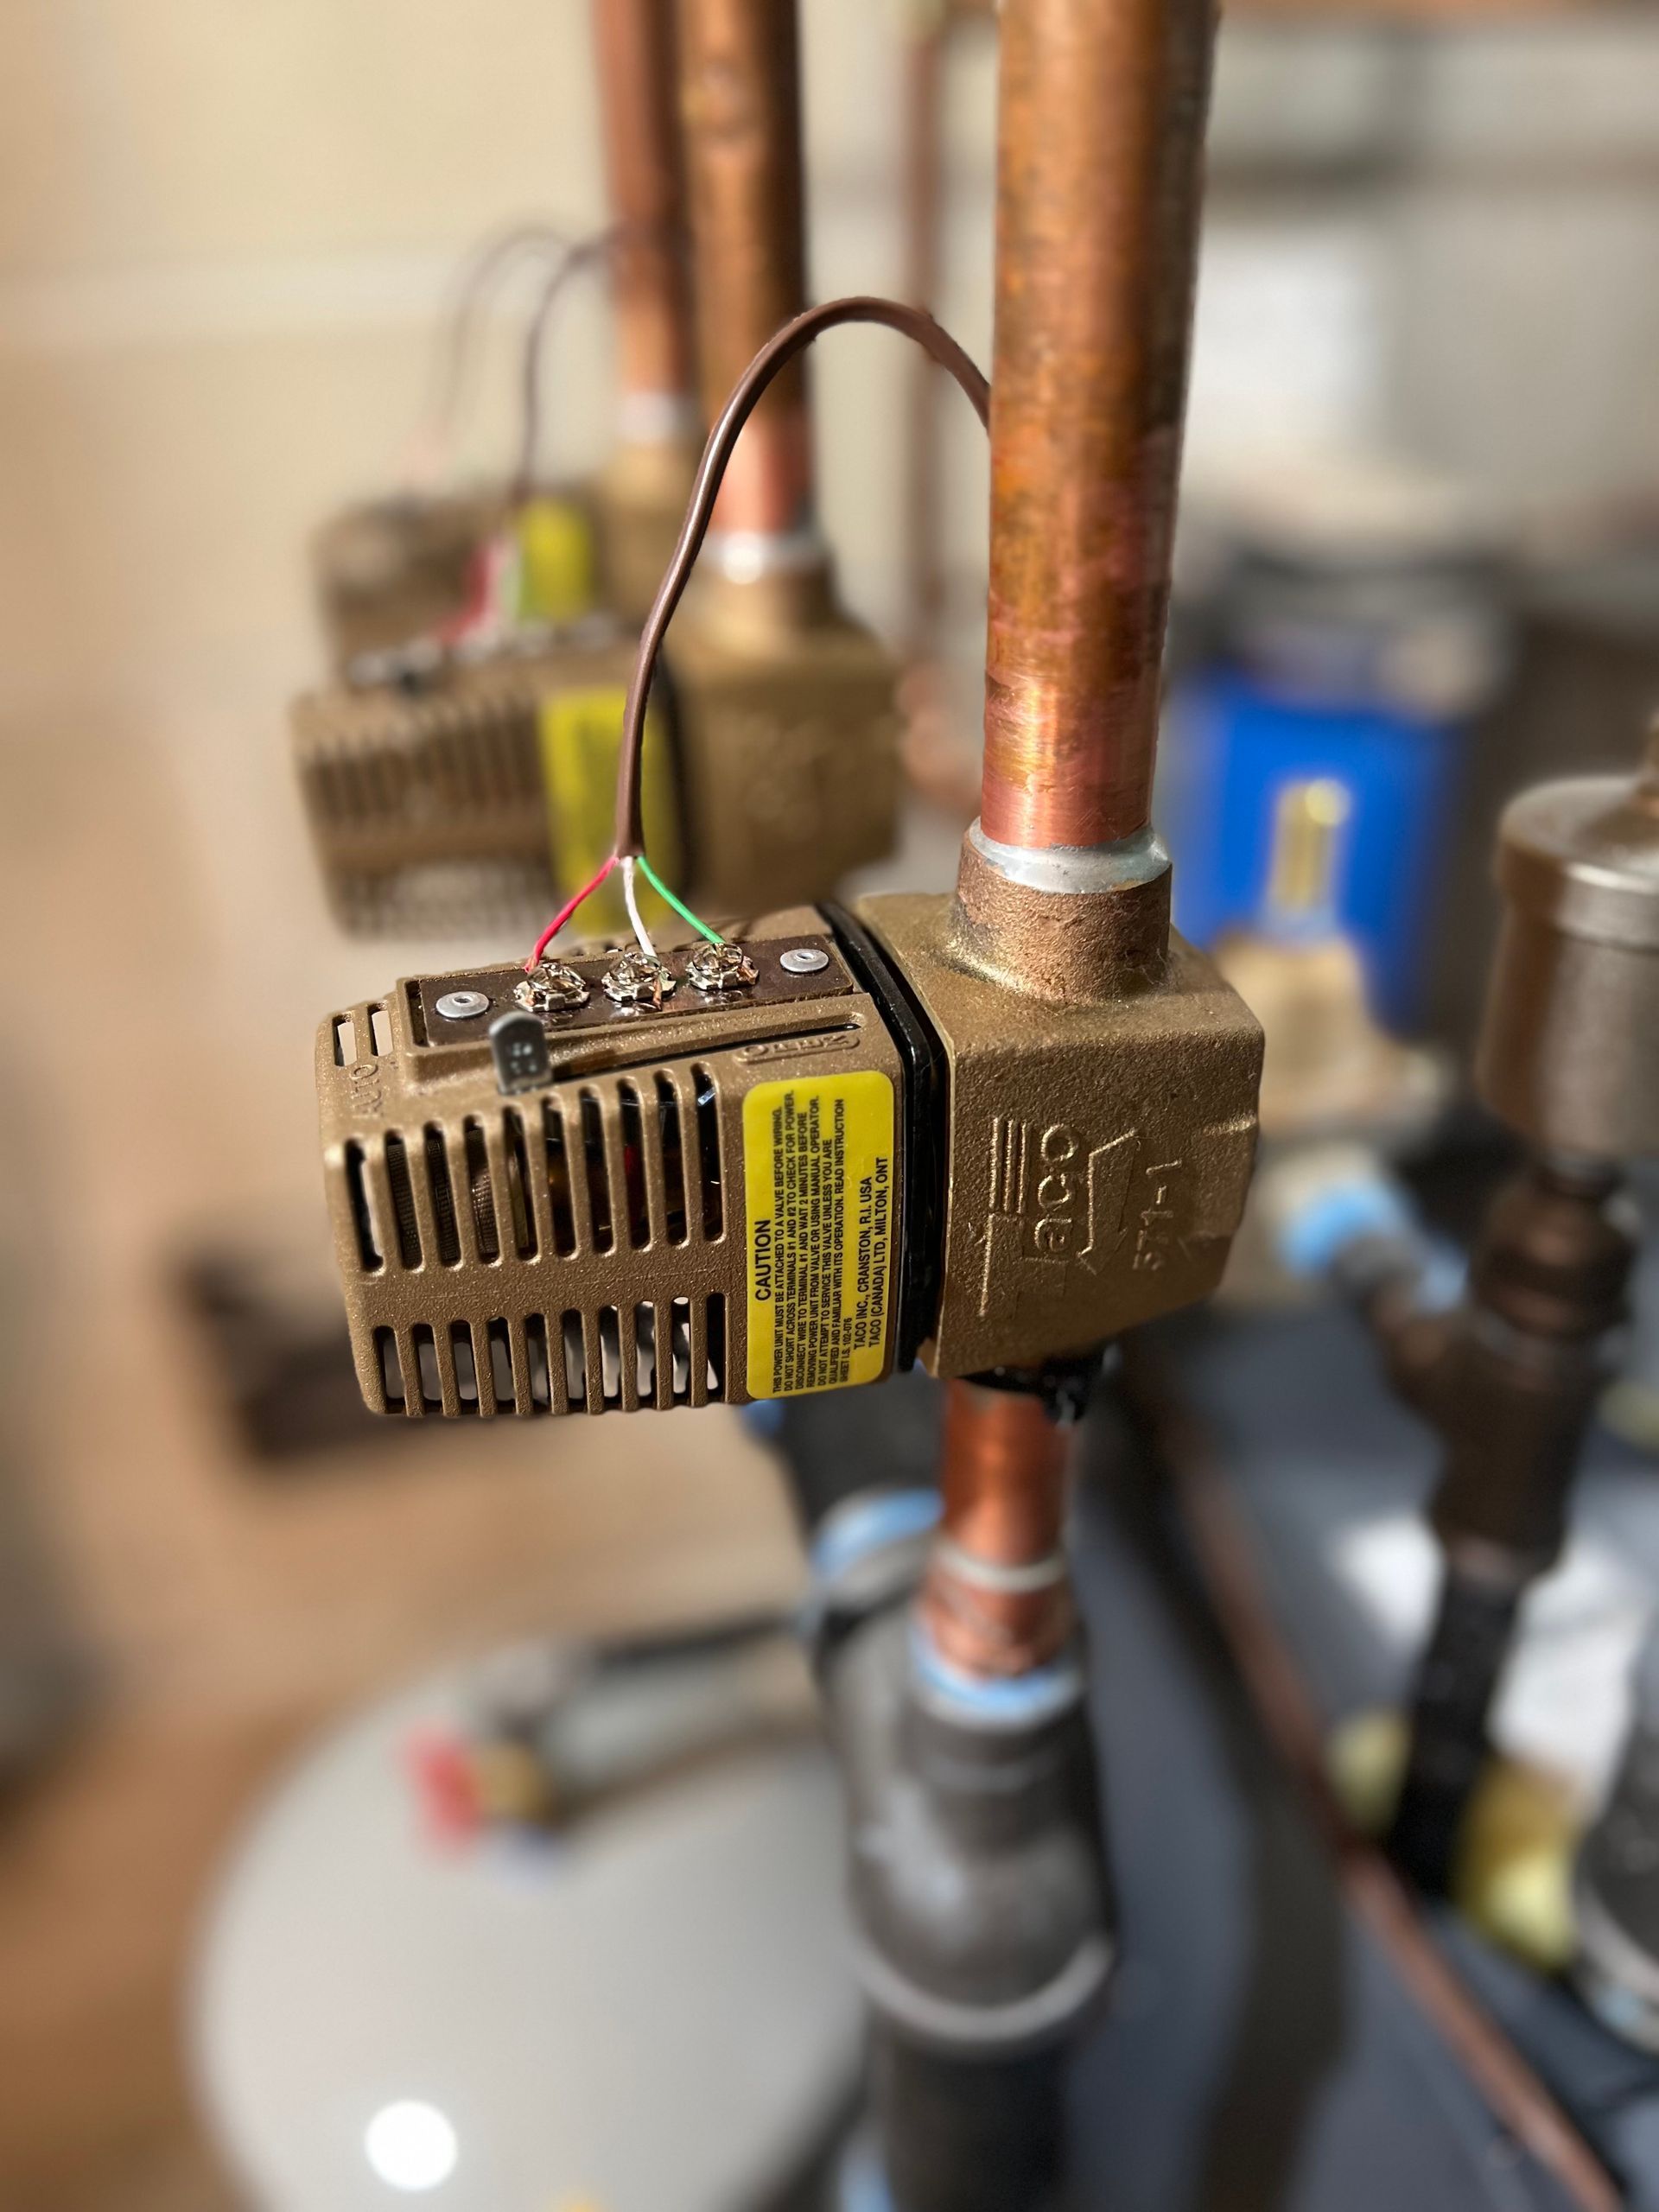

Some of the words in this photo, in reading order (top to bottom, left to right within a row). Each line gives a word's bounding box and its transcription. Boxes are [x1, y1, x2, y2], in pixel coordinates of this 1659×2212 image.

[798, 1113, 807, 1152] BEFORE
[835, 1099, 843, 1166] INSTRUCTION
[823, 1139, 831, 1159] ARE
[774, 1149, 784, 1186] BEFORE
[786, 1156, 796, 1189] CHECK
[798, 1154, 808, 1197] MINUTES
[811, 1156, 820, 1196] MANUAL
[823, 1161, 831, 1181] YOU
[835, 1168, 843, 1193] READ
[875, 1158, 887, 1183] ONT
[787, 1192, 796, 1205] TO
[823, 1184, 832, 1220] UNLESS
[860, 1177, 871, 1203] USA
[775, 1190, 784, 1218] VALVE
[811, 1198, 820, 1226] USING
[860, 1205, 871, 1224] R.I.
[874, 1186, 888, 1236] MILTON,
[799, 1208, 808, 1230] WAIT
[835, 1196, 843, 1250] OPERATION.
[775, 1230, 784, 1241] TO
[810, 1230, 819, 1242] OR
[823, 1223, 831, 1249] VALVE
[754, 1220, 771, 1300] CAUTION
[810, 1245, 819, 1272] VALVE
[822, 1253, 831, 1272] THIS
[834, 1253, 842, 1265] ITS
[858, 1227, 873, 1292] CRANSTON,
[874, 1237, 887, 1263] LTD,
[775, 1244, 784, 1289] ATTACHED
[787, 1253, 796, 1300] TERMINALS
[833, 1268, 842, 1289] WITH
[775, 1292, 784, 1302] BE
[798, 1264, 807, 1306] TERMINAL
[810, 1273, 819, 1297] FROM
[822, 1274, 830, 1307] SERVICE
[870, 1267, 887, 1317] (CANADA)
[775, 1306, 784, 1327] MUST
[787, 1303, 796, 1334] ACROSS
[798, 1309, 806, 1319] TO
[810, 1300, 818, 1318] UNIT
[821, 1311, 830, 1321] TO
[832, 1291, 842, 1327] FAMILIAR
[856, 1294, 870, 1319] INC.,
[774, 1331, 783, 1347] UNIT
[798, 1321, 806, 1341] WIRE
[809, 1320, 818, 1348] POWER
[820, 1323, 829, 1357] ATTEMPT
[831, 1330, 840, 1345] AND
[854, 1322, 866, 1350] TACO
[868, 1320, 880, 1347] TACO
[774, 1349, 783, 1376] POWER
[785, 1338, 795, 1362] SHORT
[842, 1347, 850, 1358] I.S.
[785, 1365, 794, 1379] NOT
[796, 1344, 806, 1389] DISCONNECT
[807, 1350, 817, 1388] REMOVING
[829, 1348, 839, 1383] QUALIFIED
[840, 1360, 849, 1382] SHEET
[773, 1377, 782, 1392] THIS
[785, 1382, 793, 1391] DO
[818, 1376, 826, 1386] DO
